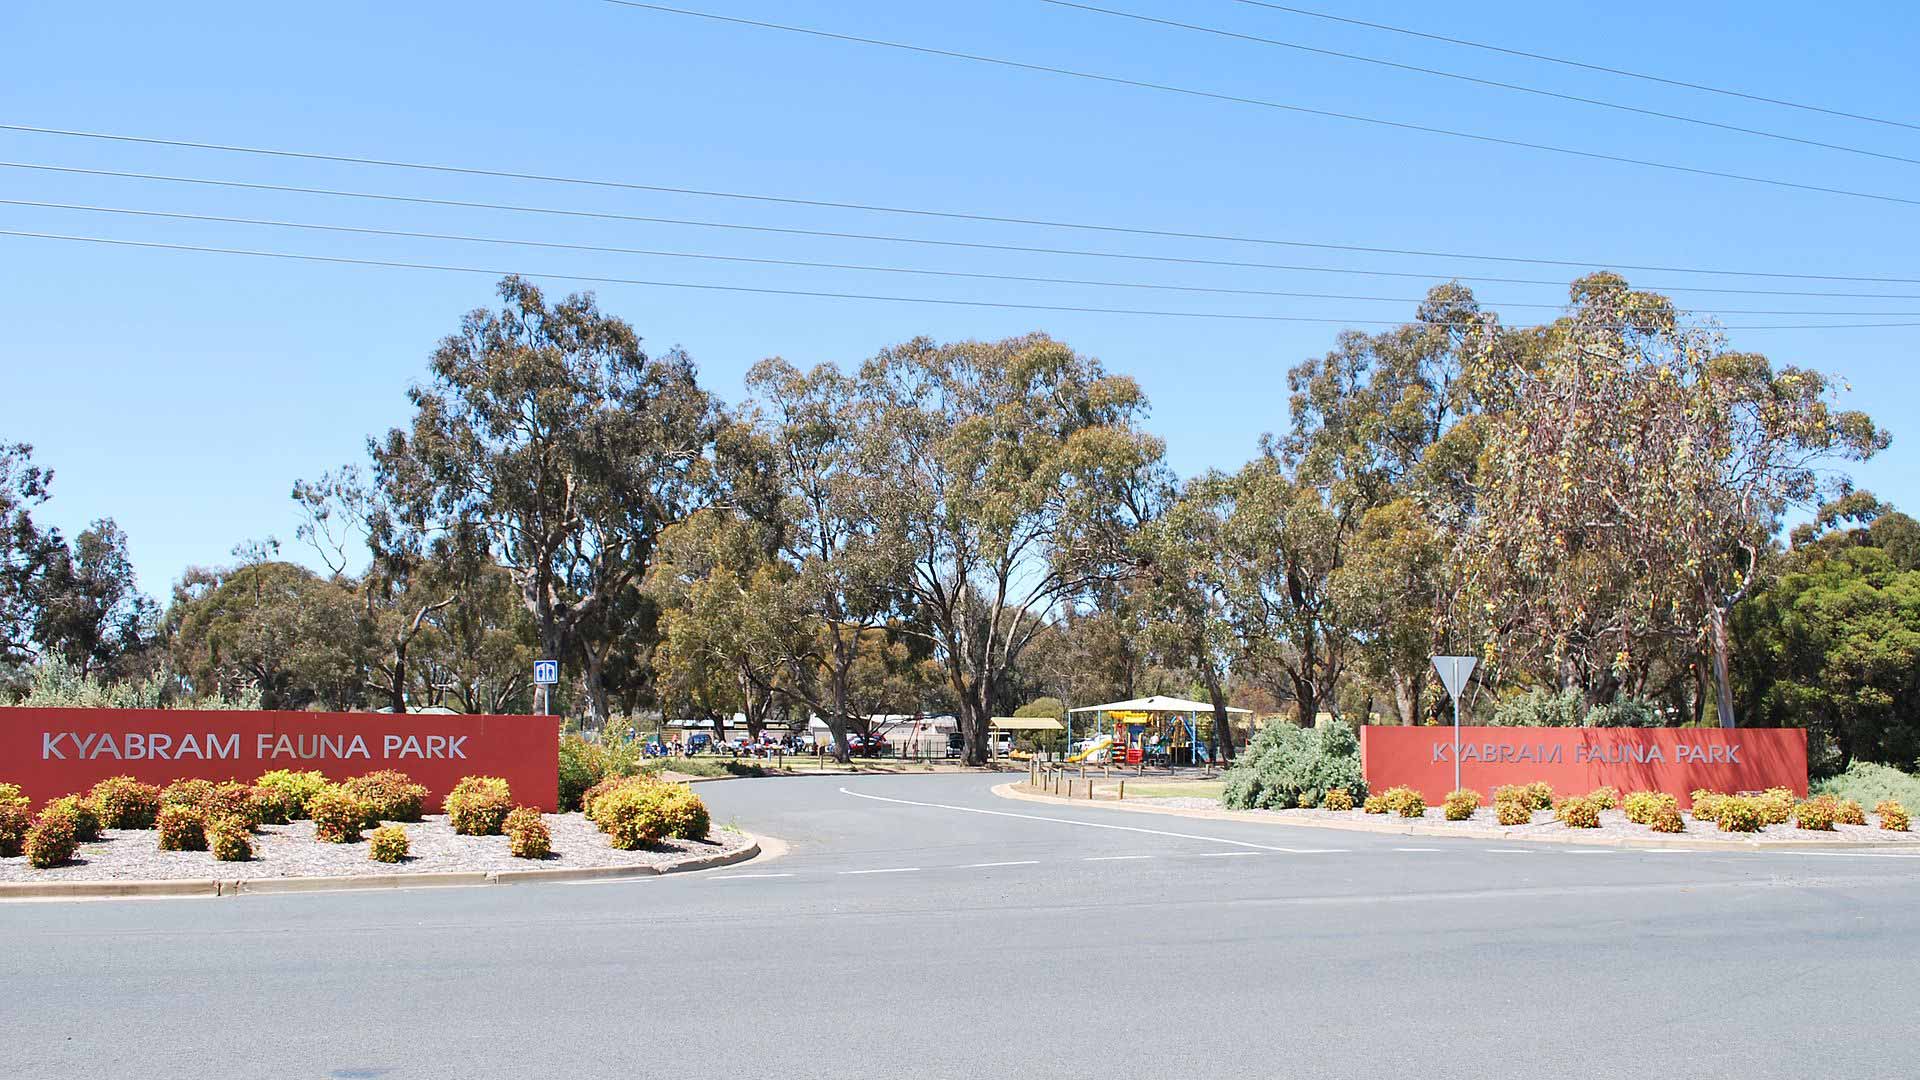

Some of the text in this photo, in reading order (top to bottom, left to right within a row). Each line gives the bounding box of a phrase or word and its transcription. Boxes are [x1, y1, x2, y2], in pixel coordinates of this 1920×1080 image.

[42, 732, 468, 760] KYABRAM FAUNA PARK
[1432, 742, 1741, 765] KYABRAM FAUNA PARK
